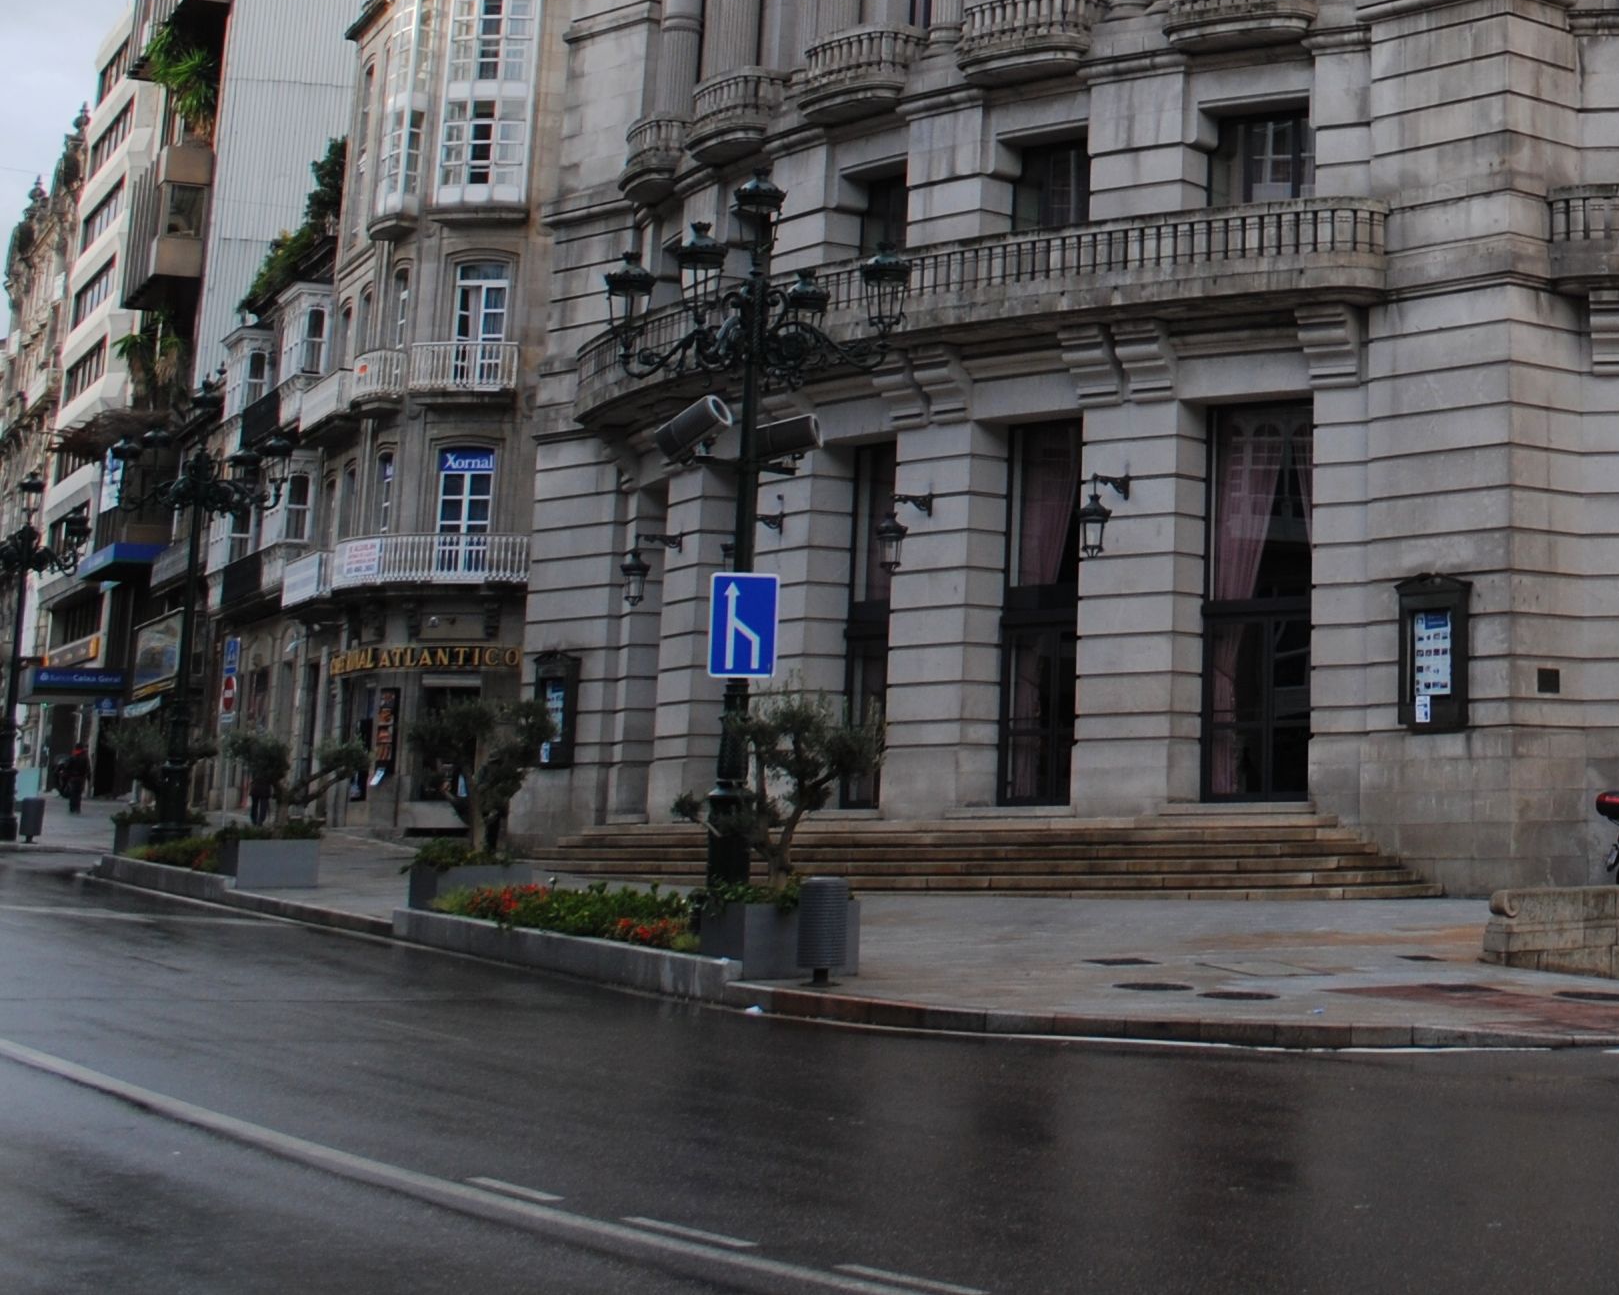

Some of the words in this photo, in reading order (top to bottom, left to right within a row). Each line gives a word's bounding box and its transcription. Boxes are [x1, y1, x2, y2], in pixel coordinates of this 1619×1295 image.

[443, 453, 494, 469] Xornal
[378, 647, 520, 667] ATLANTICO
[72, 673, 97, 682] Caixa
